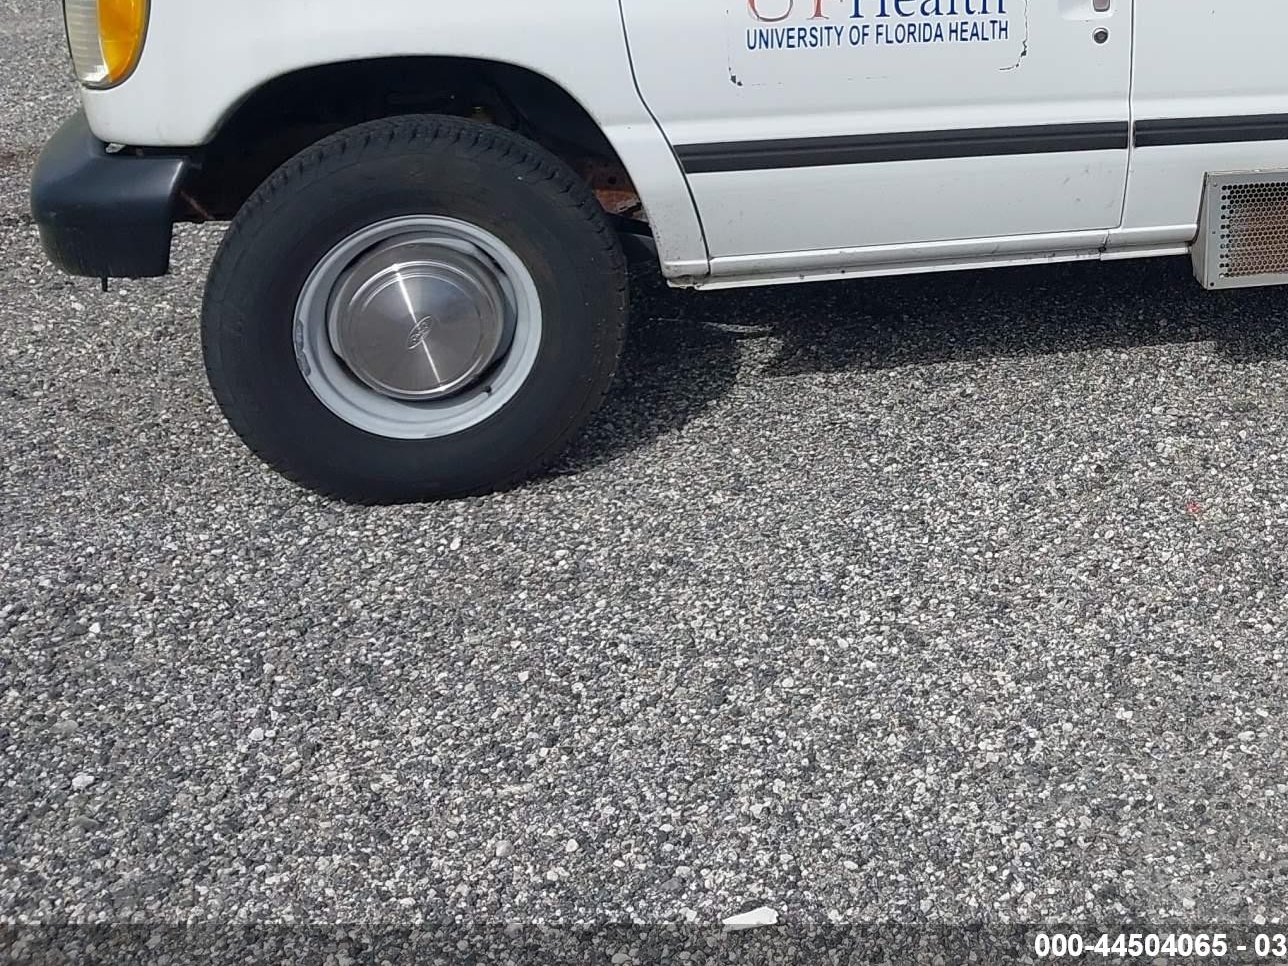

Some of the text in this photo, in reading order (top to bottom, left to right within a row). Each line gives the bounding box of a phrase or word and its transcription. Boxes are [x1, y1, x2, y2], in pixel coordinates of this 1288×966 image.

[746, 19, 1009, 50] UNIVERSITY OF FLORIDA HEALTH
